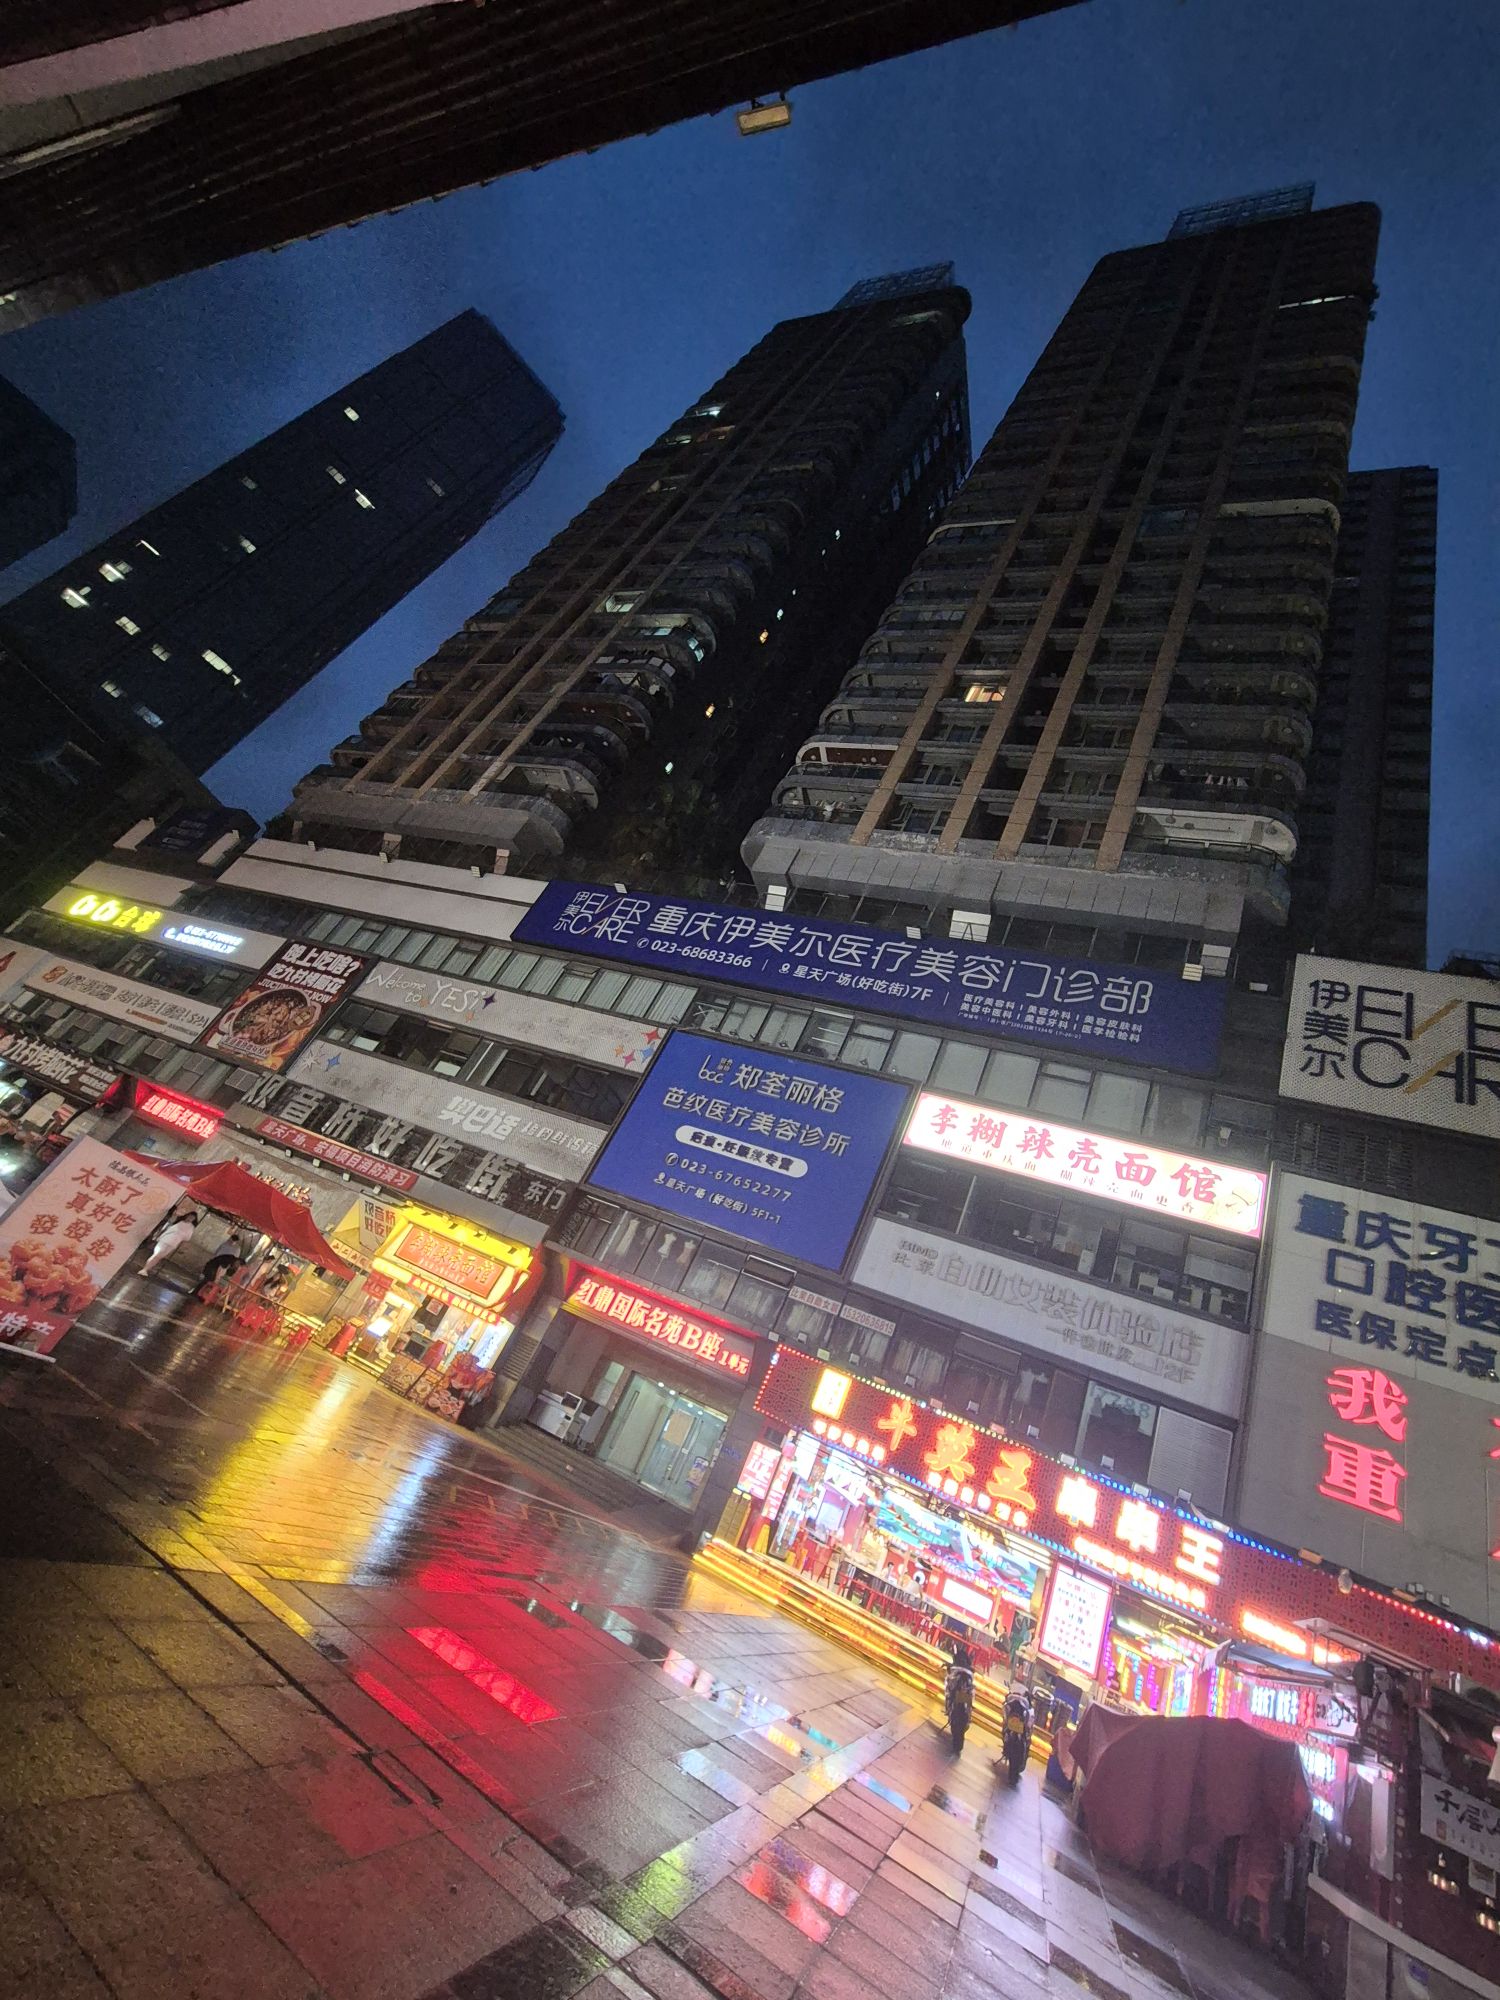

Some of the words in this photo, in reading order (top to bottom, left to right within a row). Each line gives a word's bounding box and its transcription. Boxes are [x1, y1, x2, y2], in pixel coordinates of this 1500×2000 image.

[553, 891, 590, 931] 伊美尔
[580, 893, 650, 922] EVER
[570, 914, 640, 943] CARE
[647, 904, 1153, 1015] 重庆伊美尔医疗美容门诊部
[651, 940, 752, 968] 023-68683366
[365, 967, 427, 991] Welcome
[405, 991, 421, 1003] to
[960, 1003, 1012, 1019] 美容中医科
[1024, 1014, 1068, 1030] 美容牙科
[1081, 1025, 1140, 1043] 医学检验科
[963, 993, 1015, 1010] 医疗美容科
[1027, 1004, 1071, 1021] 美容外科
[1084, 1015, 1142, 1033] 美容皮肤科
[1300, 979, 1351, 1079] 伊美尔
[730, 1063, 846, 1113] 郑荃丽格
[242, 1072, 519, 1199] 观音桥好吃街
[524, 1180, 566, 1210] 东门
[663, 1087, 851, 1157] 芭纹医疗美容诊所
[930, 1104, 1223, 1205] 李糊辣壳面馆
[71, 1167, 143, 1205] 太酥了
[680, 1159, 792, 1202] 023-67652277
[65, 1192, 136, 1234] 真好吃
[364, 1200, 395, 1227] 观音桥
[1295, 1194, 1500, 1282] 重庆牙
[576, 1278, 724, 1361] 红鼎国际名苑B座
